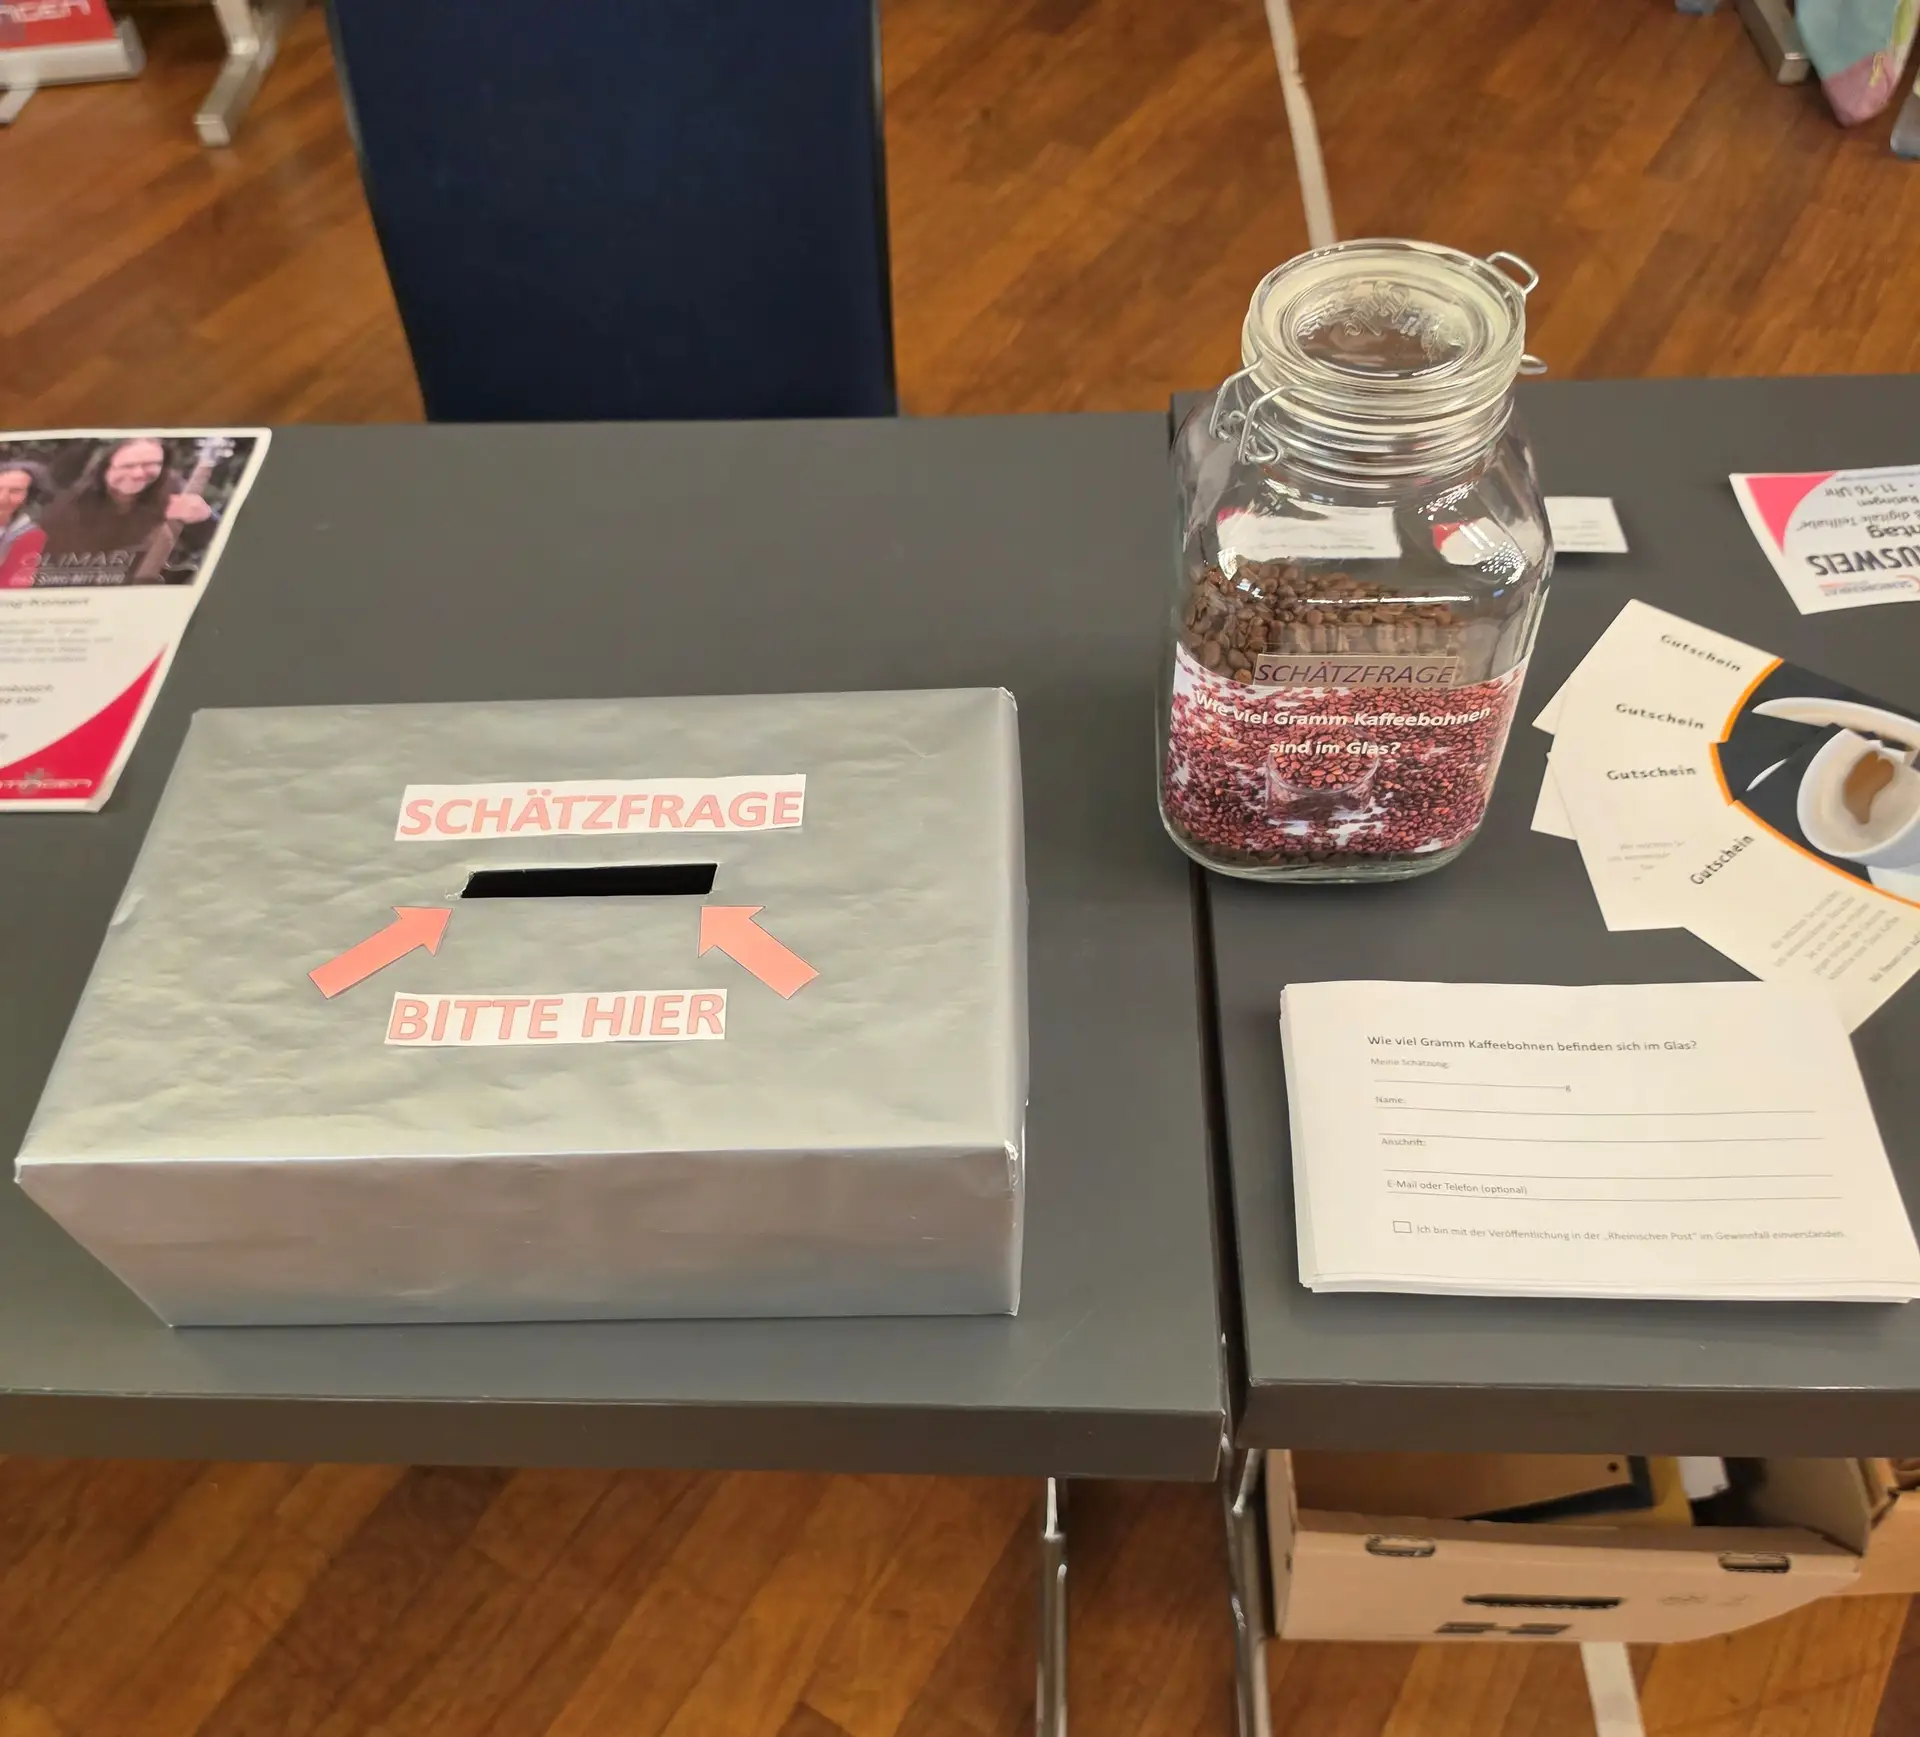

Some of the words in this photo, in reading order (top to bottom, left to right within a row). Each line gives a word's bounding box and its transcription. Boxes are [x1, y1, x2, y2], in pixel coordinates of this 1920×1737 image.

[1825, 487, 1851, 497] Uhr
[1858, 510, 1910, 523] digitale
[1660, 634, 1742, 672] Gutschein
[1254, 661, 1456, 685] SCHÄTZFRAGE
[1194, 689, 1234, 717] Wie
[1234, 708, 1268, 725] viel
[1274, 712, 1348, 726] Gramm
[1353, 707, 1491, 727] Kaffeebohnen
[1616, 703, 1705, 730] Gutschein
[1269, 741, 1308, 754] sind
[1316, 741, 1340, 754] im
[1346, 741, 1401, 755] Glas?
[1606, 765, 1697, 781] Gutschein
[400, 788, 803, 835] SCHÄTZFRAGE
[1689, 835, 1755, 885] Gutschein
[388, 998, 563, 1041] BITTE
[581, 993, 724, 1037] HIER
[1367, 1035, 1392, 1045] Wie
[1395, 1036, 1417, 1046] viel
[1420, 1037, 1465, 1048] Gramm
[1469, 1039, 1554, 1051] Kaffeebohnen
[1557, 1042, 1613, 1051] befinden
[1616, 1041, 1641, 1051] sich
[1644, 1041, 1660, 1050] im
[1663, 1040, 1698, 1050] Glas?
[1370, 1058, 1400, 1066] Meine
[1386, 1179, 1417, 1189] E-Mail
[1420, 1181, 1442, 1190] oder
[1444, 1182, 1479, 1192] Telefon
[1481, 1185, 1527, 1195] (optional)
[1417, 1225, 1431, 1234] Ich
[1434, 1226, 1449, 1235] bin
[1451, 1227, 1468, 1236] mit
[1470, 1228, 1486, 1237] der
[1489, 1228, 1570, 1241] Veröffentlichung
[1572, 1230, 1581, 1240] in
[1584, 1231, 1601, 1240] der
[1700, 1231, 1714, 1240] im
[1716, 1230, 1770, 1241] Gewinnfall
